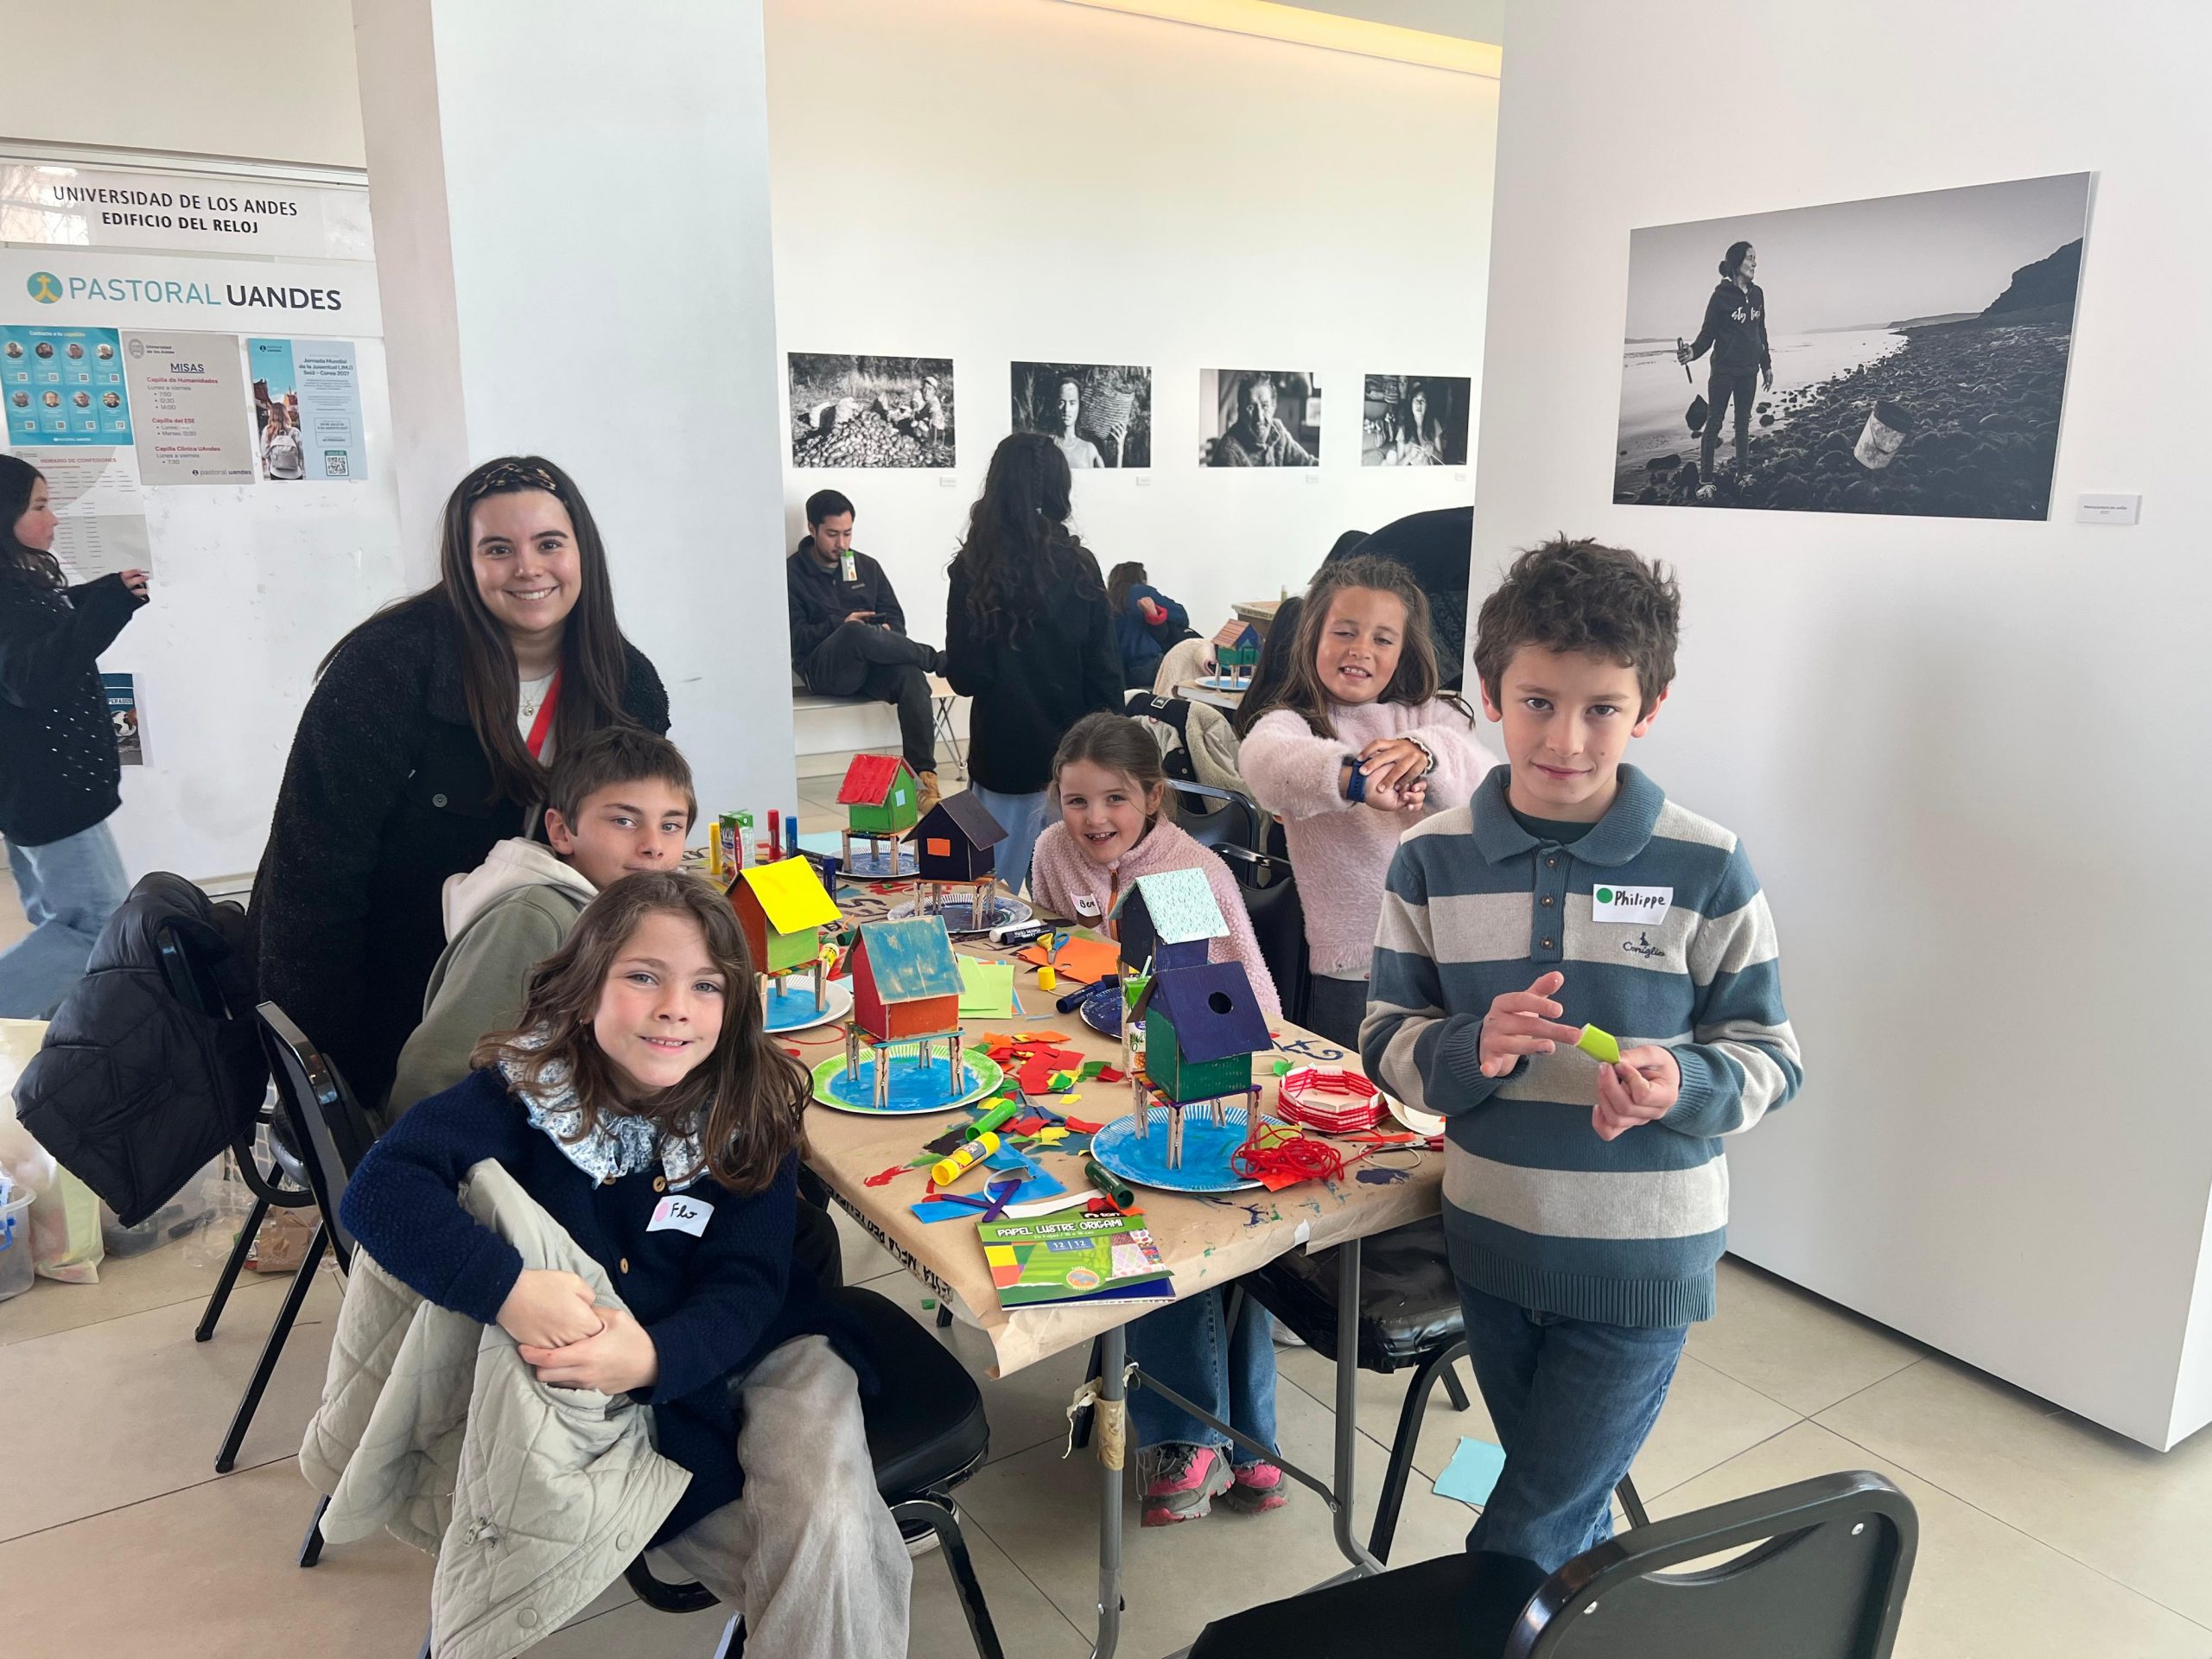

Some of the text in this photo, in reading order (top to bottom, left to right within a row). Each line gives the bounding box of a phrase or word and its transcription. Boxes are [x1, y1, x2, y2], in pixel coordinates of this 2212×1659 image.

[54, 186, 297, 216] UNIVERSIDAD DE LOS ANDES
[102, 212, 258, 234] EDIFICIO DEL RELOJ
[69, 276, 342, 311] PASTORAL UANDES
[170, 363, 205, 372] MISAS
[1614, 891, 1666, 909] Philippe
[1623, 942, 1665, 959] Coniglio
[997, 1218, 1123, 1236] PAPEL LUSTRE ORIGAMI
